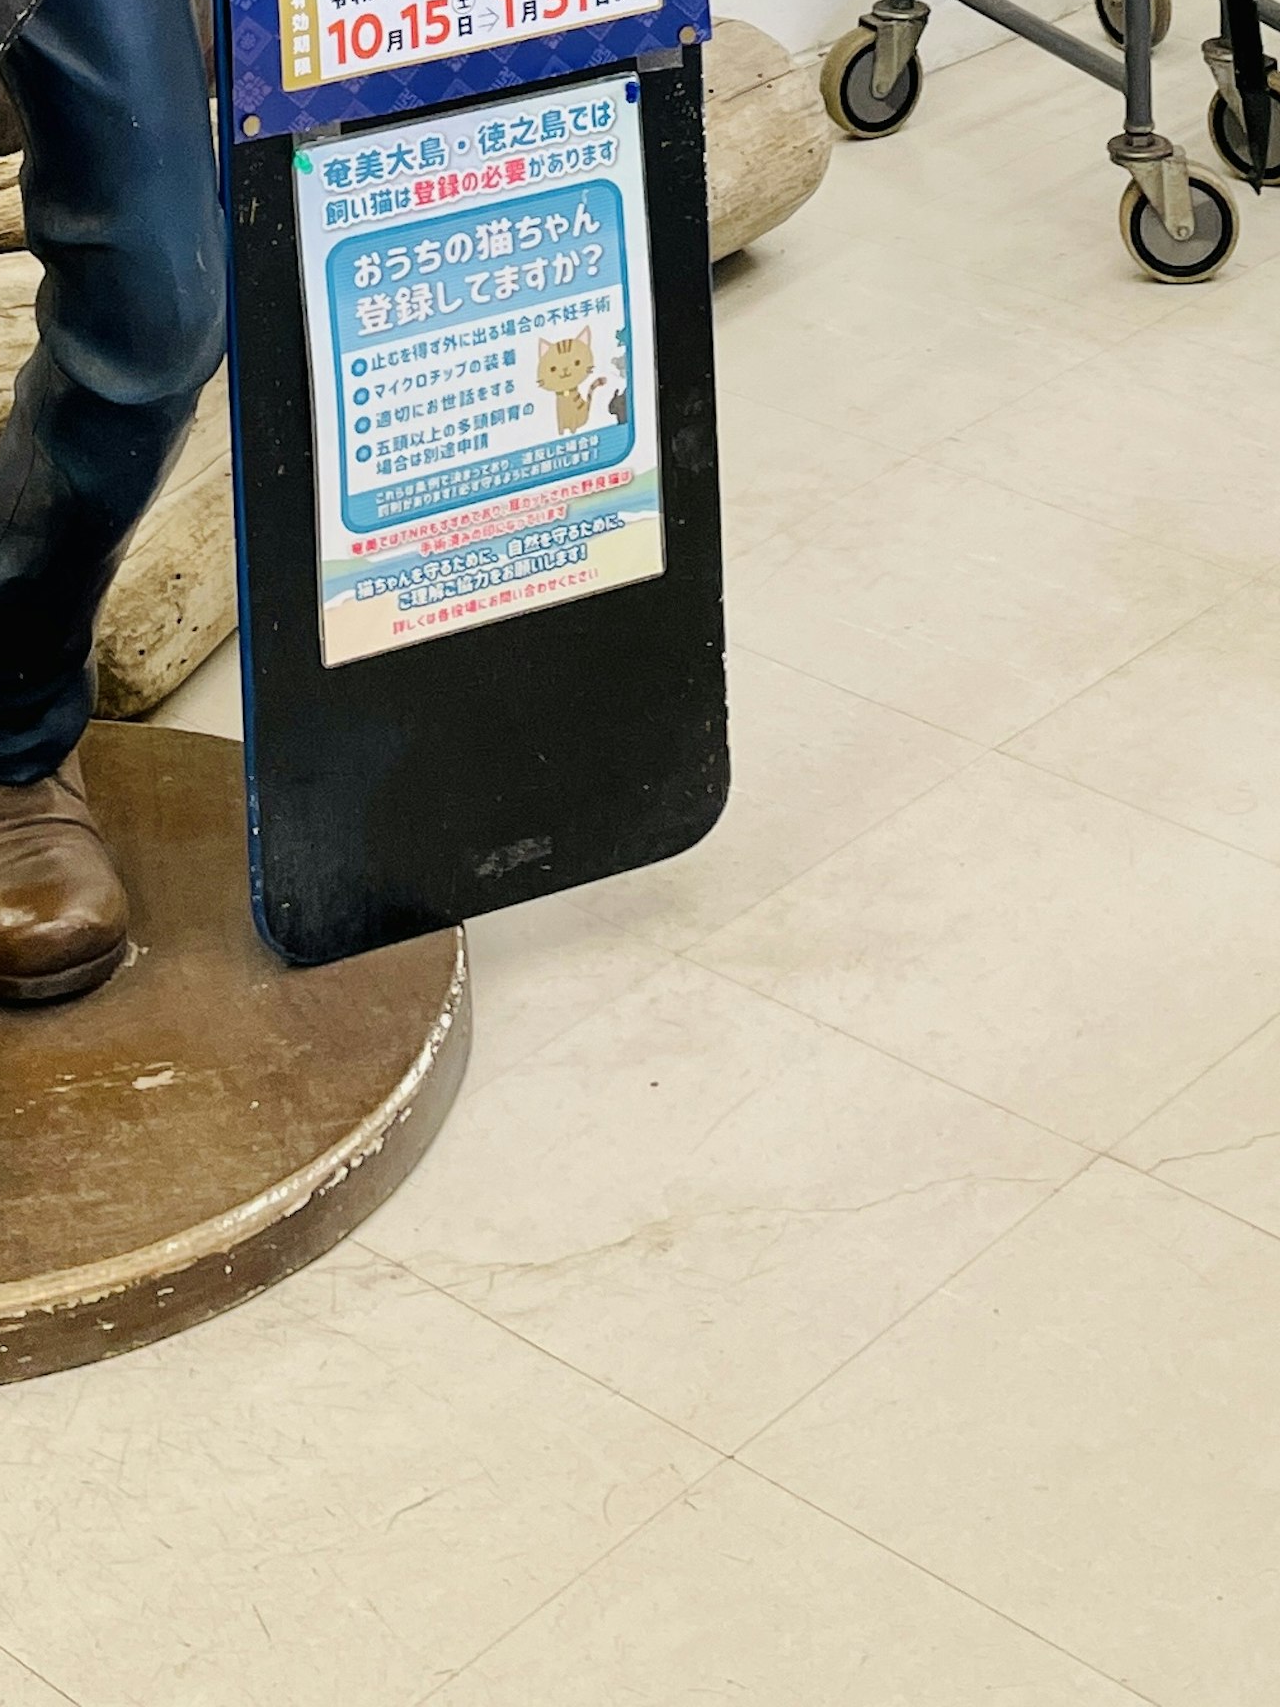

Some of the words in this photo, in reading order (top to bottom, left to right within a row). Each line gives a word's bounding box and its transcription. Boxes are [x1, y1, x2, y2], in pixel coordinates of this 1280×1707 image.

[322, 100, 612, 189] 奄美大島・徳之島では
[325, 139, 615, 227] 飼い猫は登録の必要があります
[353, 201, 602, 289] おうちの猫ちゃん
[355, 243, 604, 337] 登録してますか？
[370, 295, 611, 372] 止むを得ず外に出る場合の不妊手術
[374, 349, 517, 399] マイクロチップの装着
[375, 379, 516, 430] 適切にお世話をする
[375, 403, 535, 458] 五頭以上の多頭飼育の
[376, 432, 490, 476] 場合は別途申請
[391, 568, 600, 635] 詳しくは各役場にお問い合わせください
